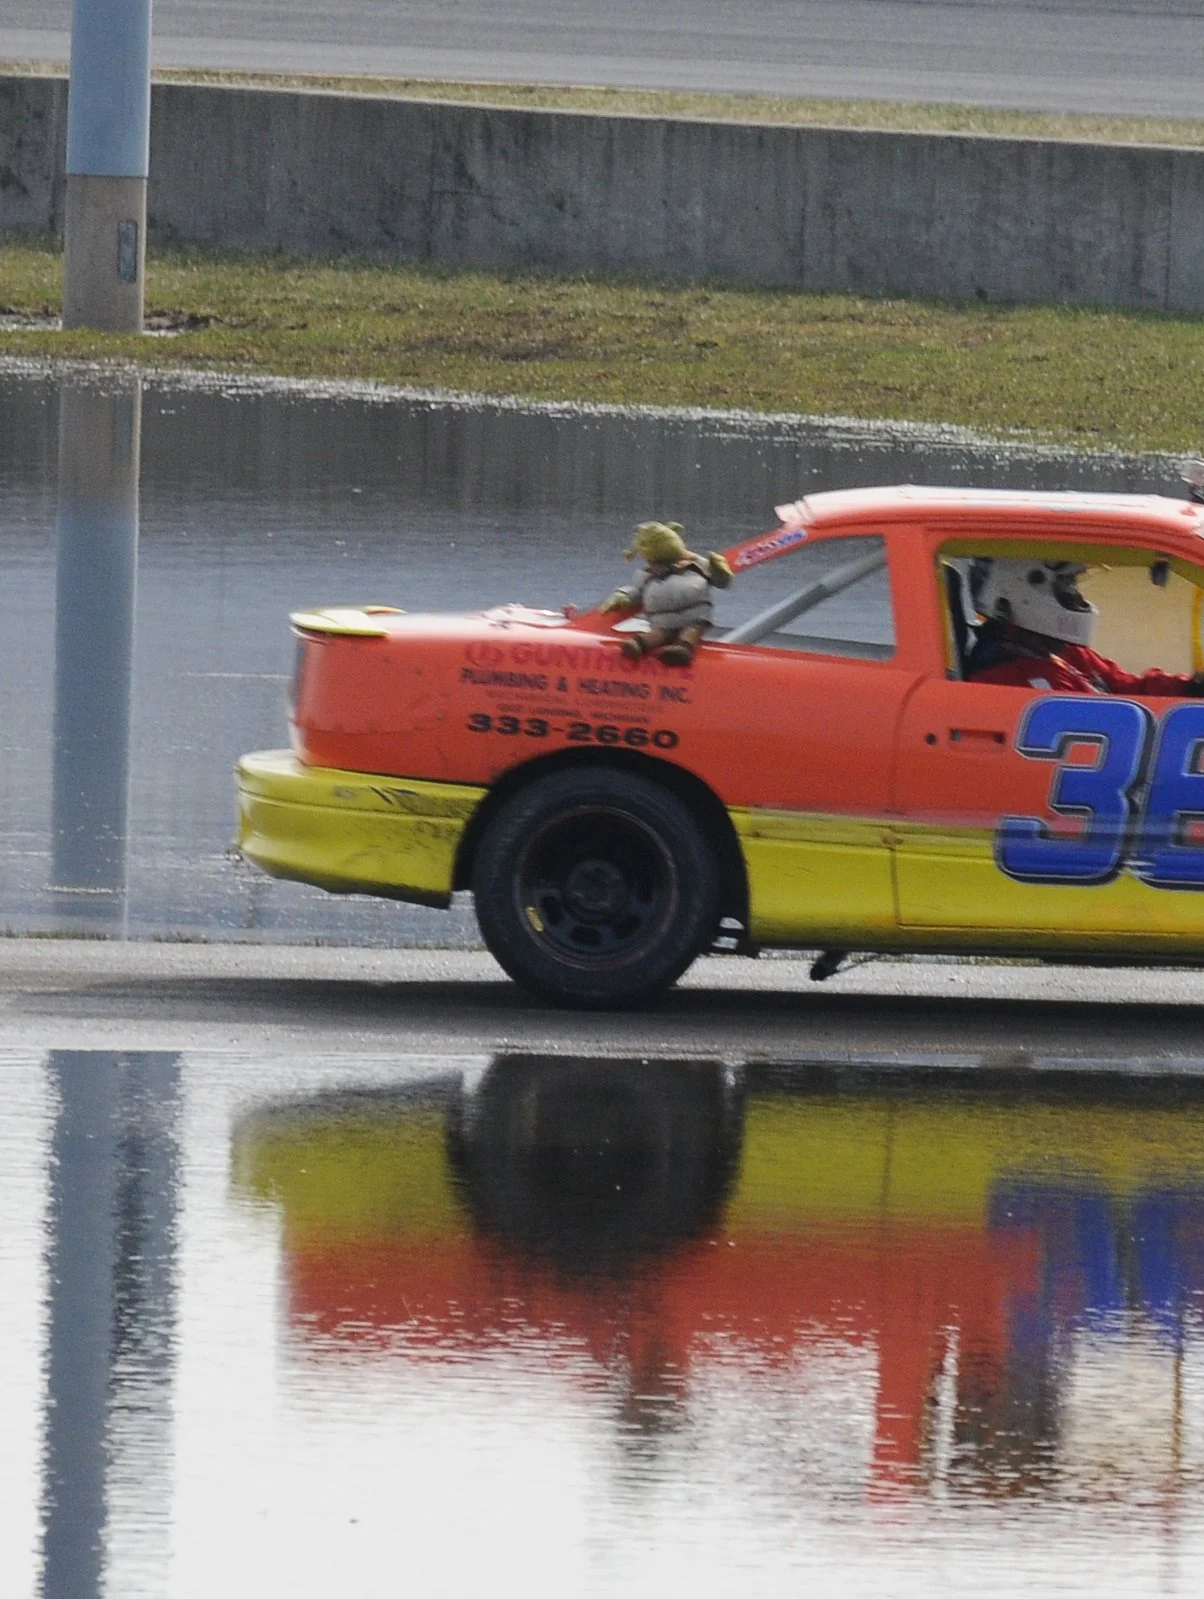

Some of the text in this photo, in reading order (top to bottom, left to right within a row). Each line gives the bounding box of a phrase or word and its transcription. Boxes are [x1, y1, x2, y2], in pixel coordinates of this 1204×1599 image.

[461, 667, 548, 691] PLUMBING
[555, 675, 569, 693] &
[577, 677, 651, 700] HEATING
[466, 712, 679, 750] 333-2660
